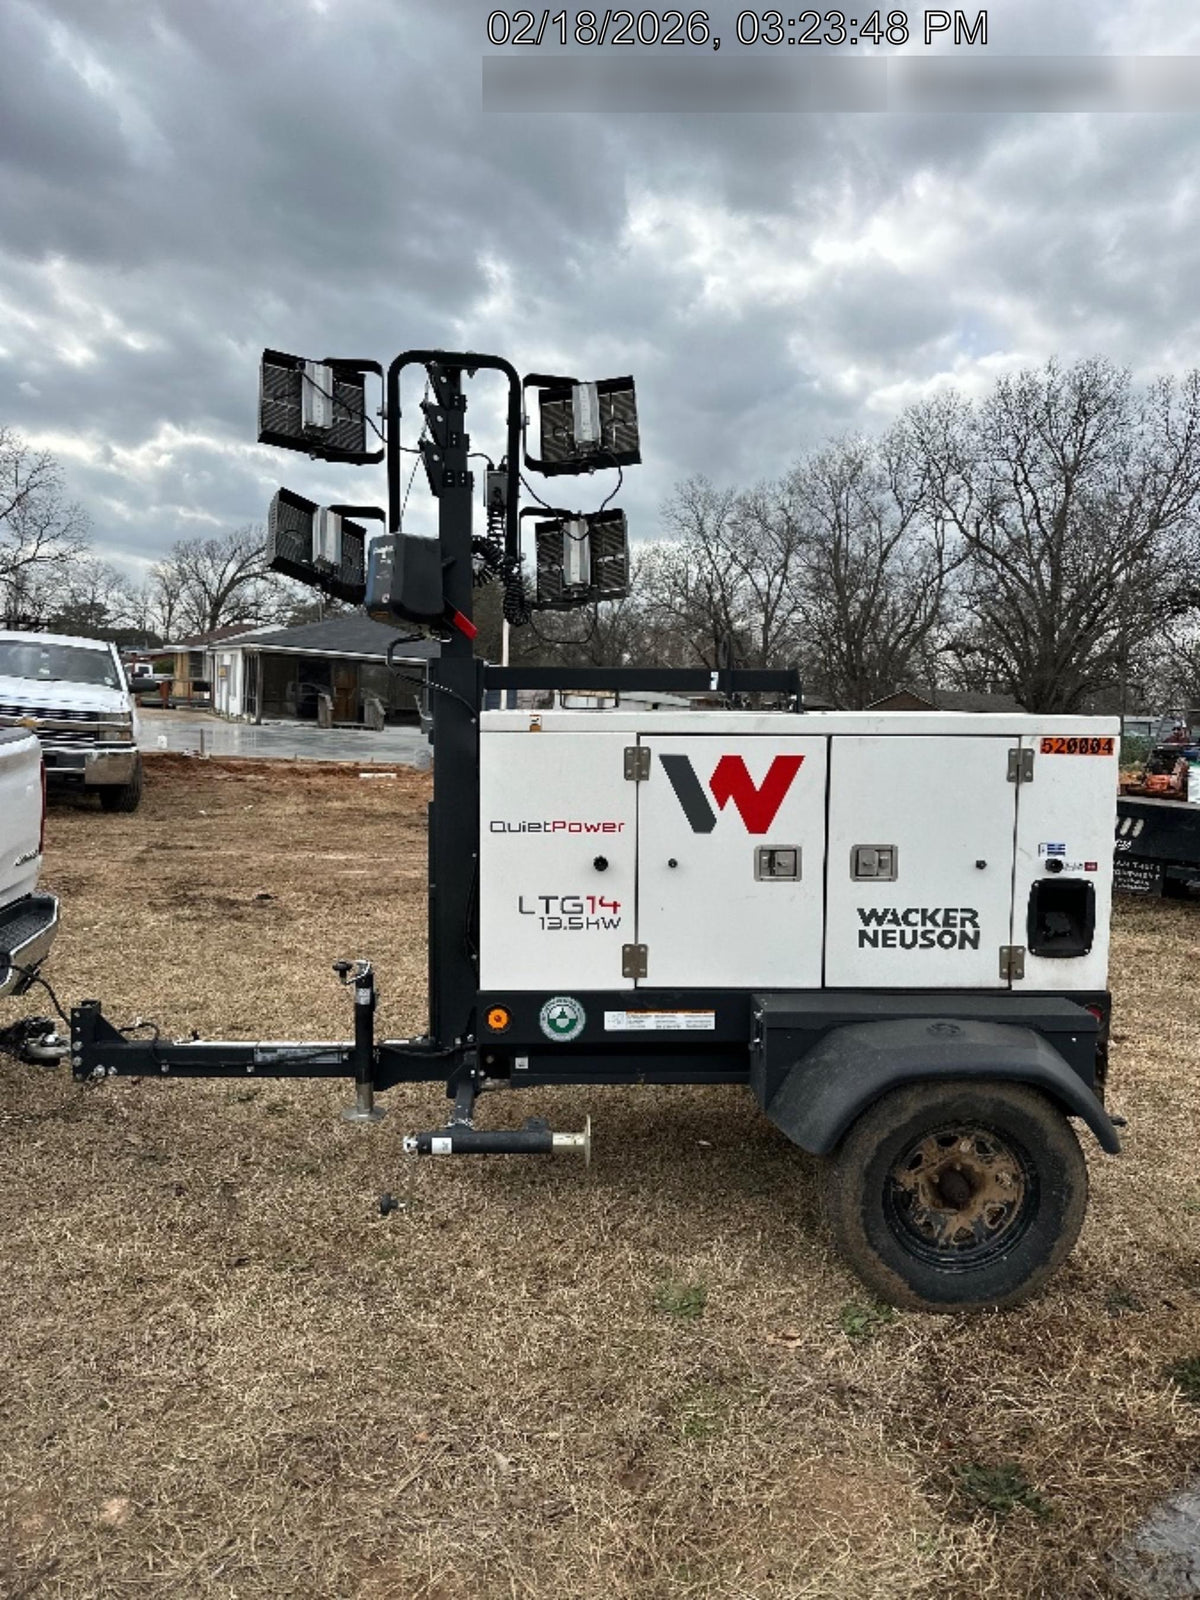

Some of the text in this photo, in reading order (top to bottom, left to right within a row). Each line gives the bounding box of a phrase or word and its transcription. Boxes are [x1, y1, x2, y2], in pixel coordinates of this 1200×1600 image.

[1041, 738, 1113, 754] 520004
[489, 820, 625, 833] QuietPower
[518, 895, 621, 914] LTG14
[857, 908, 980, 928] WACKER
[858, 929, 980, 950] NEUSON
